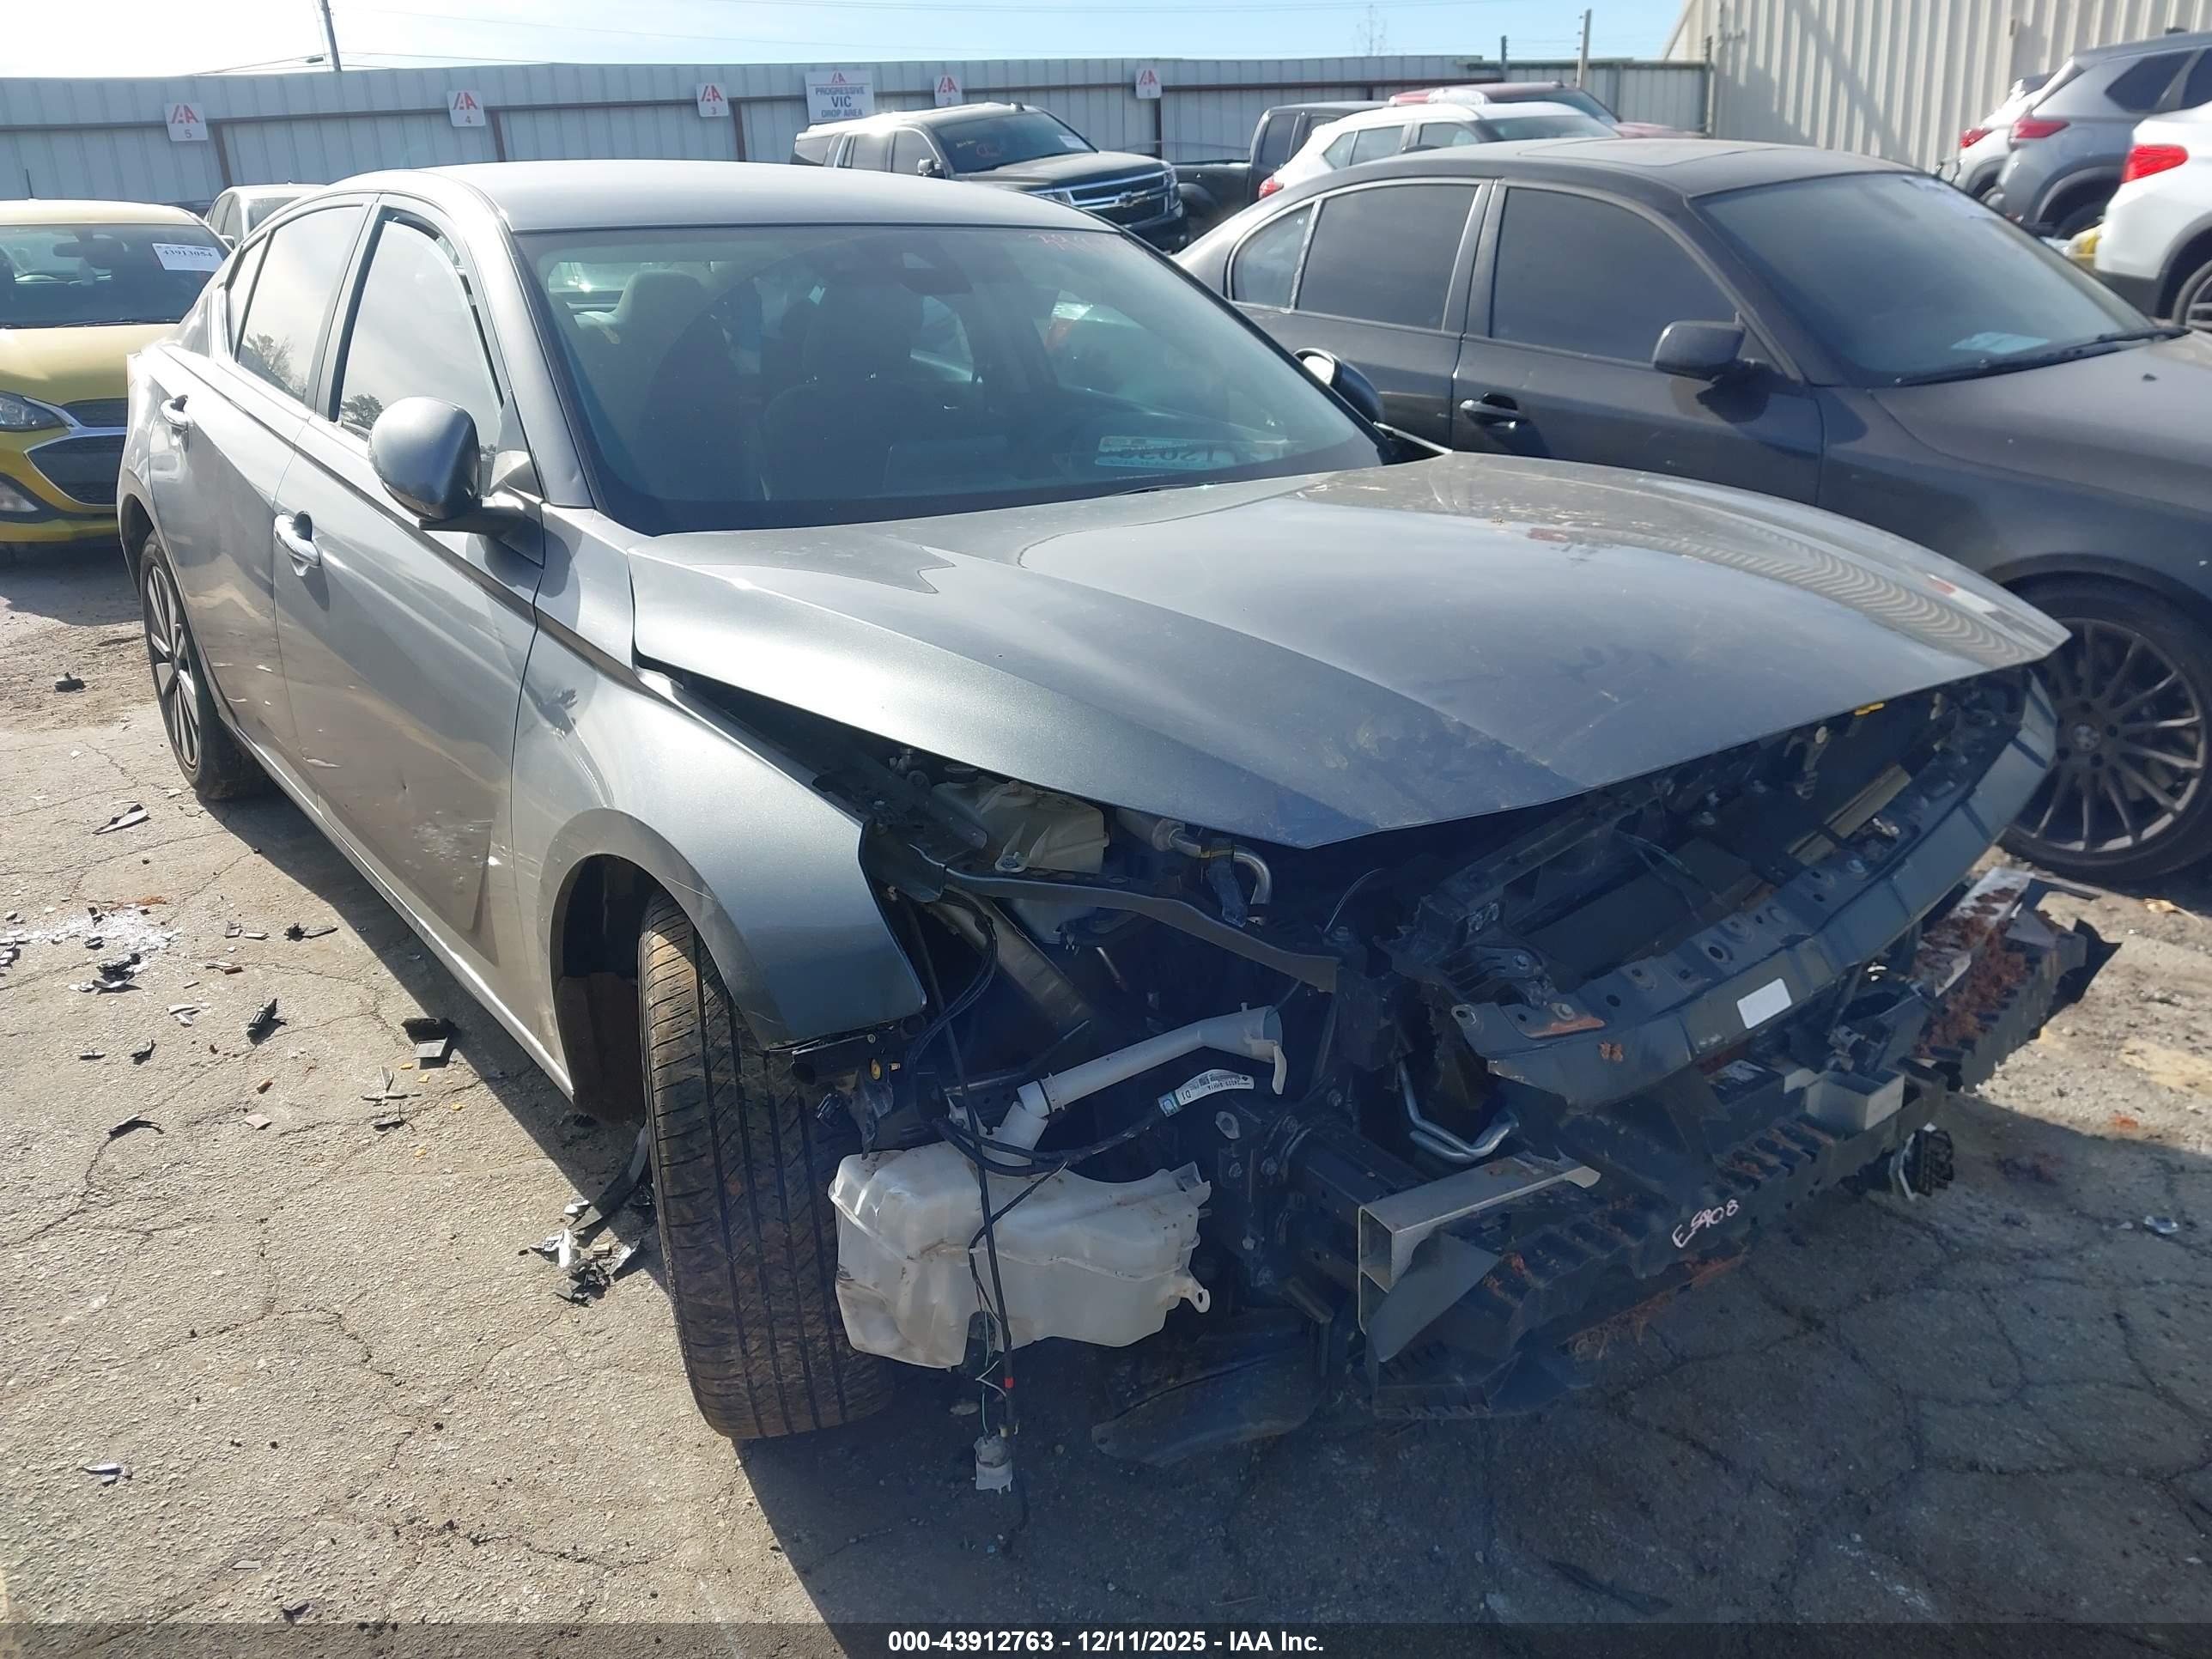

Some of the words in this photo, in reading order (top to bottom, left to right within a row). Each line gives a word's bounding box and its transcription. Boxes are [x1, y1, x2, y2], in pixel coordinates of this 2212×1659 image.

[815, 87, 865, 95] PROGRESSIVE
[831, 95, 852, 108] VIC
[821, 109, 841, 118] DROP
[843, 108, 863, 118] AREA
[465, 115, 471, 125] 4
[185, 129, 192, 138] 5
